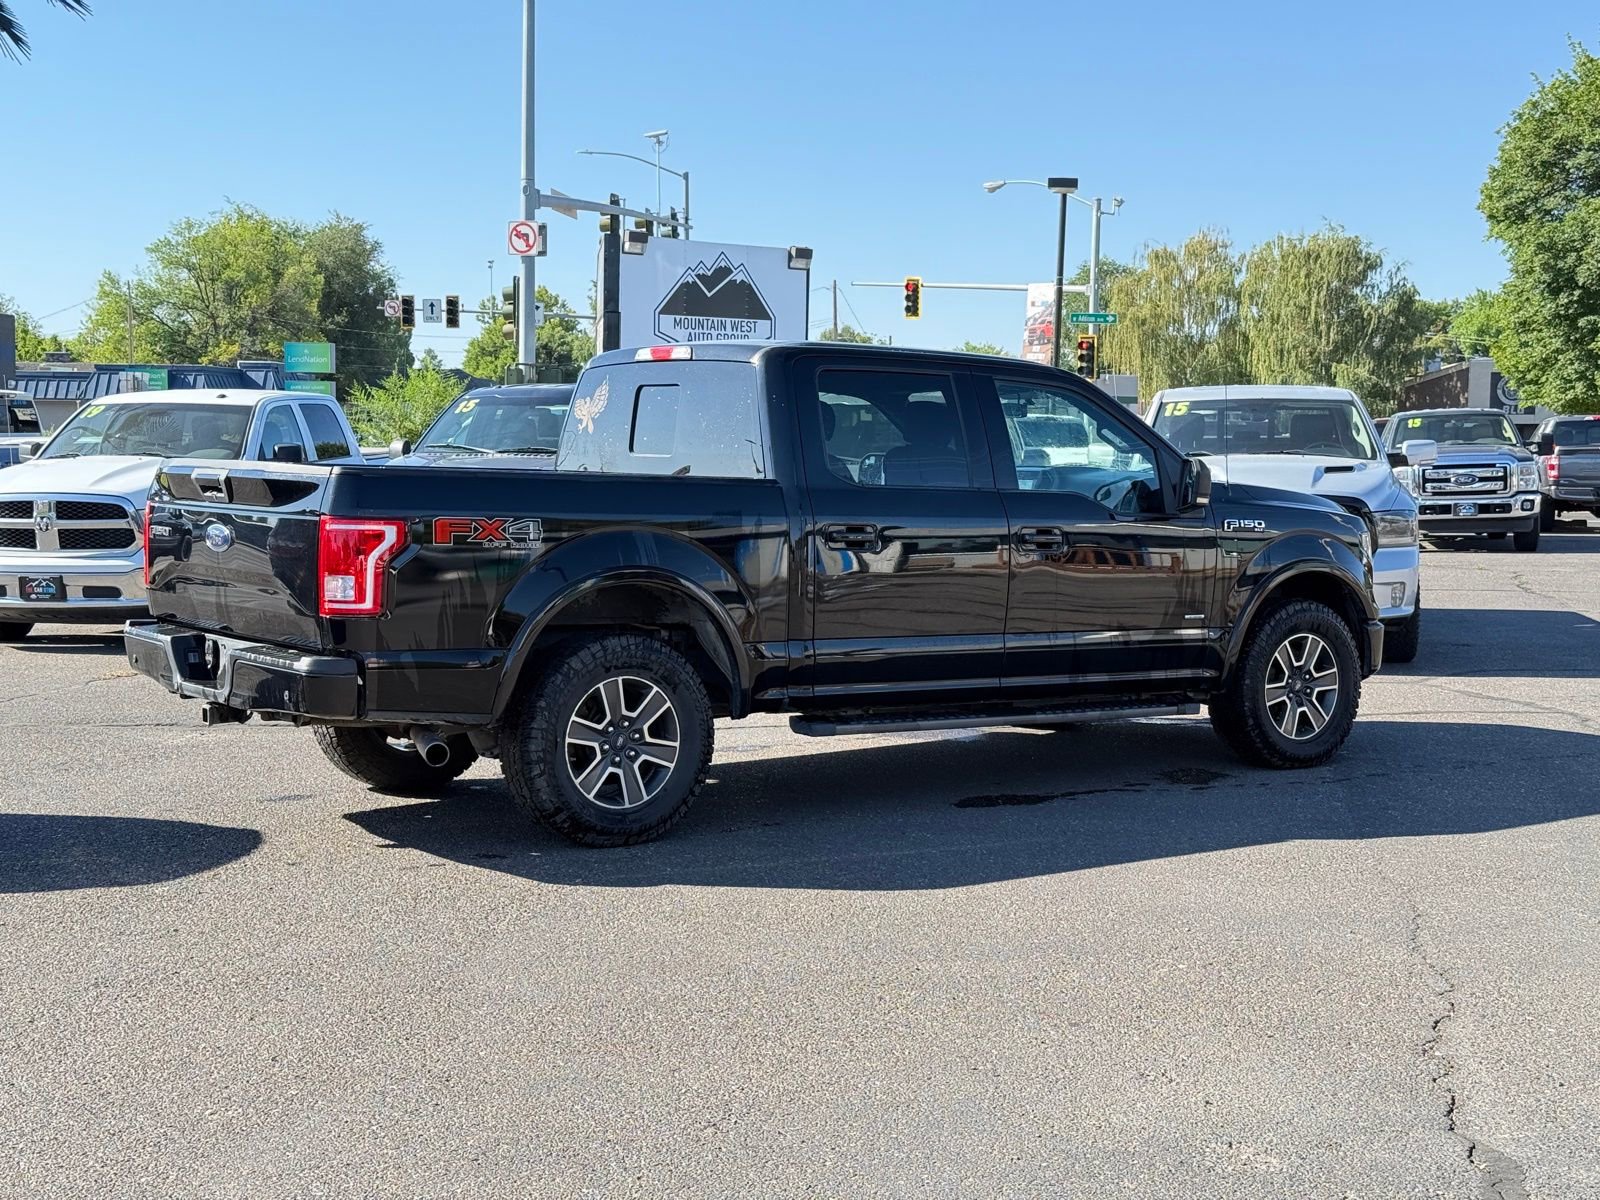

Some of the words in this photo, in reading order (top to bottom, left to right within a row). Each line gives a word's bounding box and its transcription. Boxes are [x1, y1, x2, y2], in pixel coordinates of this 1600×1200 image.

[673, 317, 727, 332] MOUNTAIN
[730, 320, 758, 333] WEST
[687, 332, 713, 342] AUTO
[288, 355, 328, 363] LendNation
[80, 405, 106, 419] 19
[454, 399, 480, 414] 15
[1164, 402, 1190, 417] 15
[1407, 418, 1422, 429] 15
[433, 516, 543, 546] FX4
[1224, 519, 1266, 532] F150
